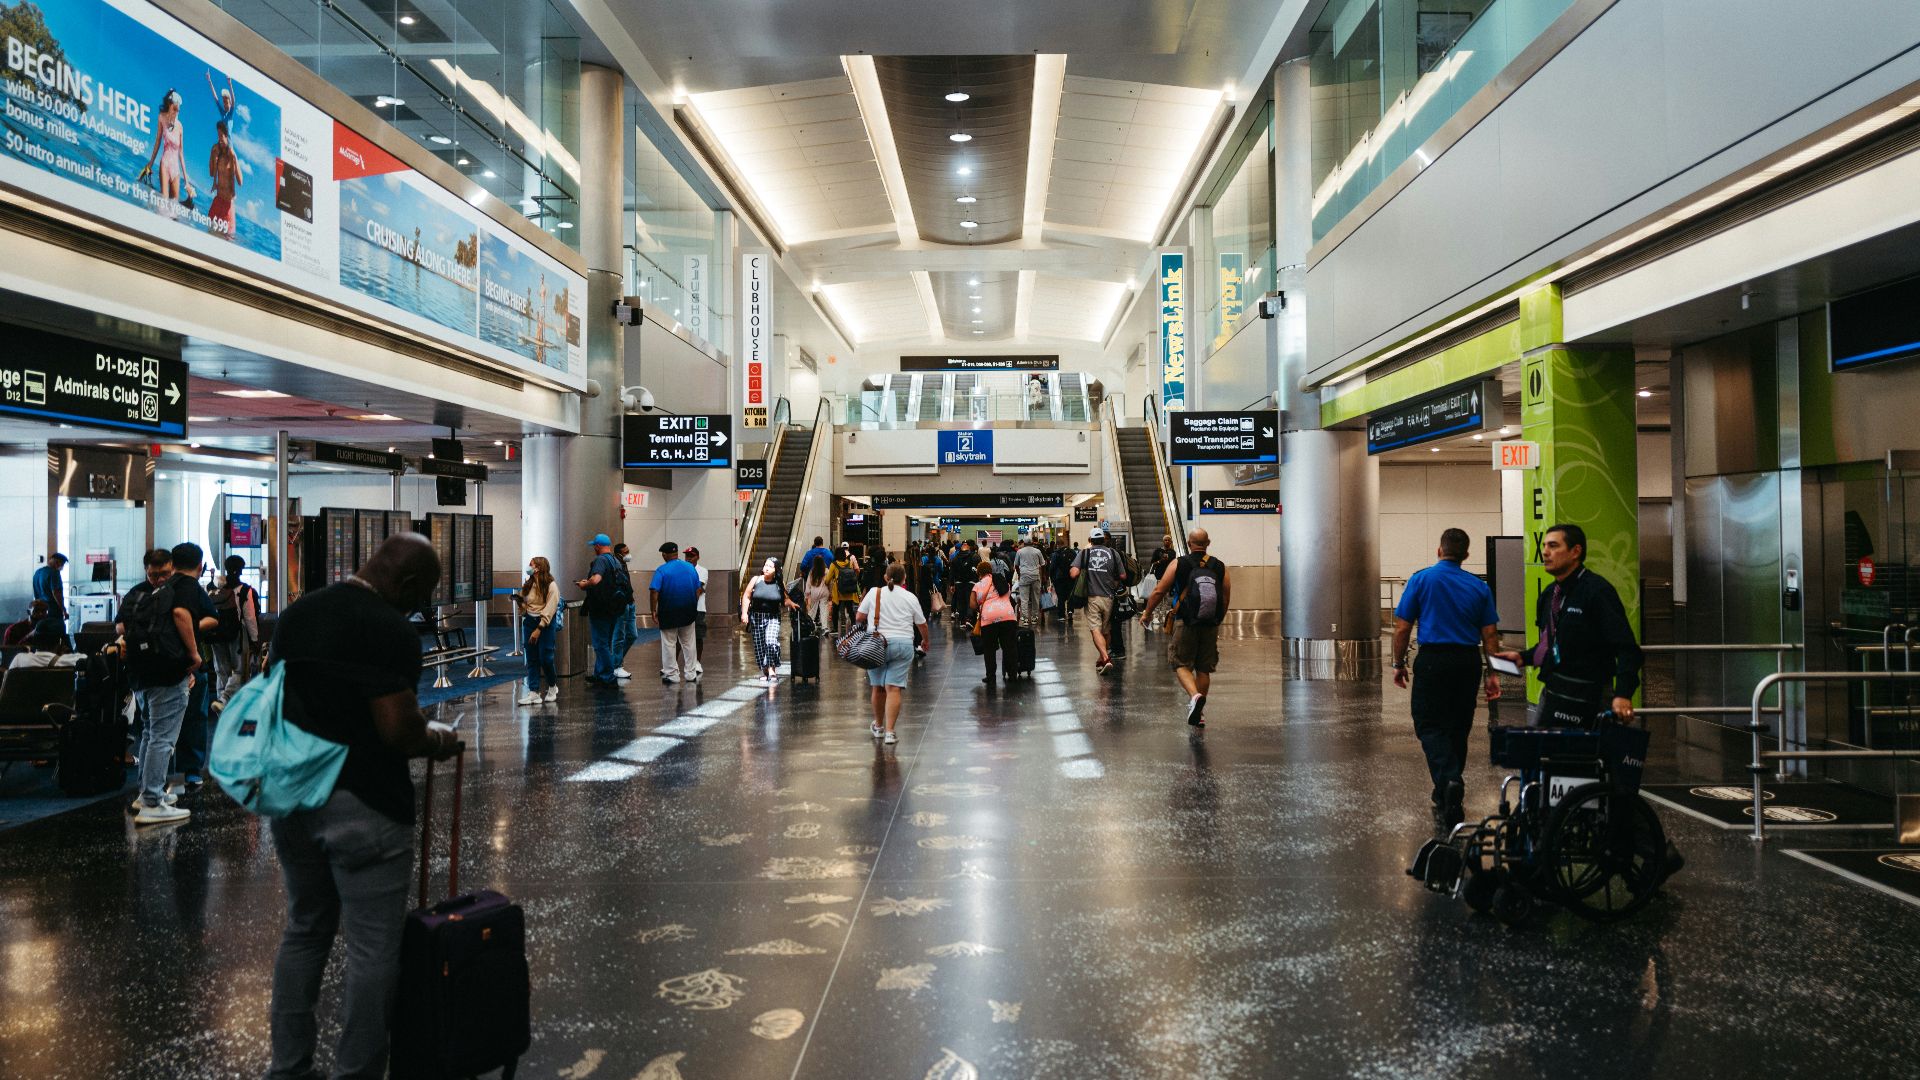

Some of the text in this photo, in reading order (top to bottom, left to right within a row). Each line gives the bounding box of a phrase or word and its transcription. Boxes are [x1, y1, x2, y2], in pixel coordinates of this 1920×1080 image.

[7, 35, 151, 135] BEGINS HERE
[6, 79, 35, 104] with
[37, 90, 79, 123] 50,000
[6, 97, 80, 146] bonus miles.
[6, 130, 23, 152] $0
[25, 138, 55, 164] intro
[56, 154, 94, 180] annual
[96, 167, 114, 188] fee
[115, 177, 132, 194] for
[132, 183, 149, 202] the
[150, 189, 170, 210] first
[171, 198, 192, 220] year,
[193, 207, 213, 227] then
[366, 219, 414, 259] CRUISING
[415, 244, 446, 275] ALONG
[447, 260, 471, 286] THERE
[485, 278, 510, 306] BEGINS
[510, 291, 527, 314] HERE
[750, 257, 760, 361] CLUBHOUSE
[1162, 267, 1184, 384] NewsLink
[95, 353, 140, 379] D1-D25
[0, 368, 140, 406] ge Admirals Club
[750, 364, 761, 402] one
[6, 389, 21, 401] D12
[744, 407, 767, 416] KITCHEN
[659, 417, 693, 430] EXIT
[744, 417, 767, 426] & BAR
[1183, 417, 1239, 427] Baggage Claim
[649, 434, 693, 443] Terminal
[961, 437, 971, 450] 2
[1175, 435, 1239, 444] Ground Transport
[336, 449, 387, 466] FLIGHT INFORMATION
[650, 449, 693, 460] F, G, H, J
[955, 452, 986, 462] skytrain
[1501, 445, 1530, 466] EXIT
[740, 468, 763, 478] D25
[627, 493, 645, 505] EXIT
[738, 491, 749, 501] EXIT
[1553, 710, 1583, 727] envoy
[1551, 783, 1564, 800] AA
